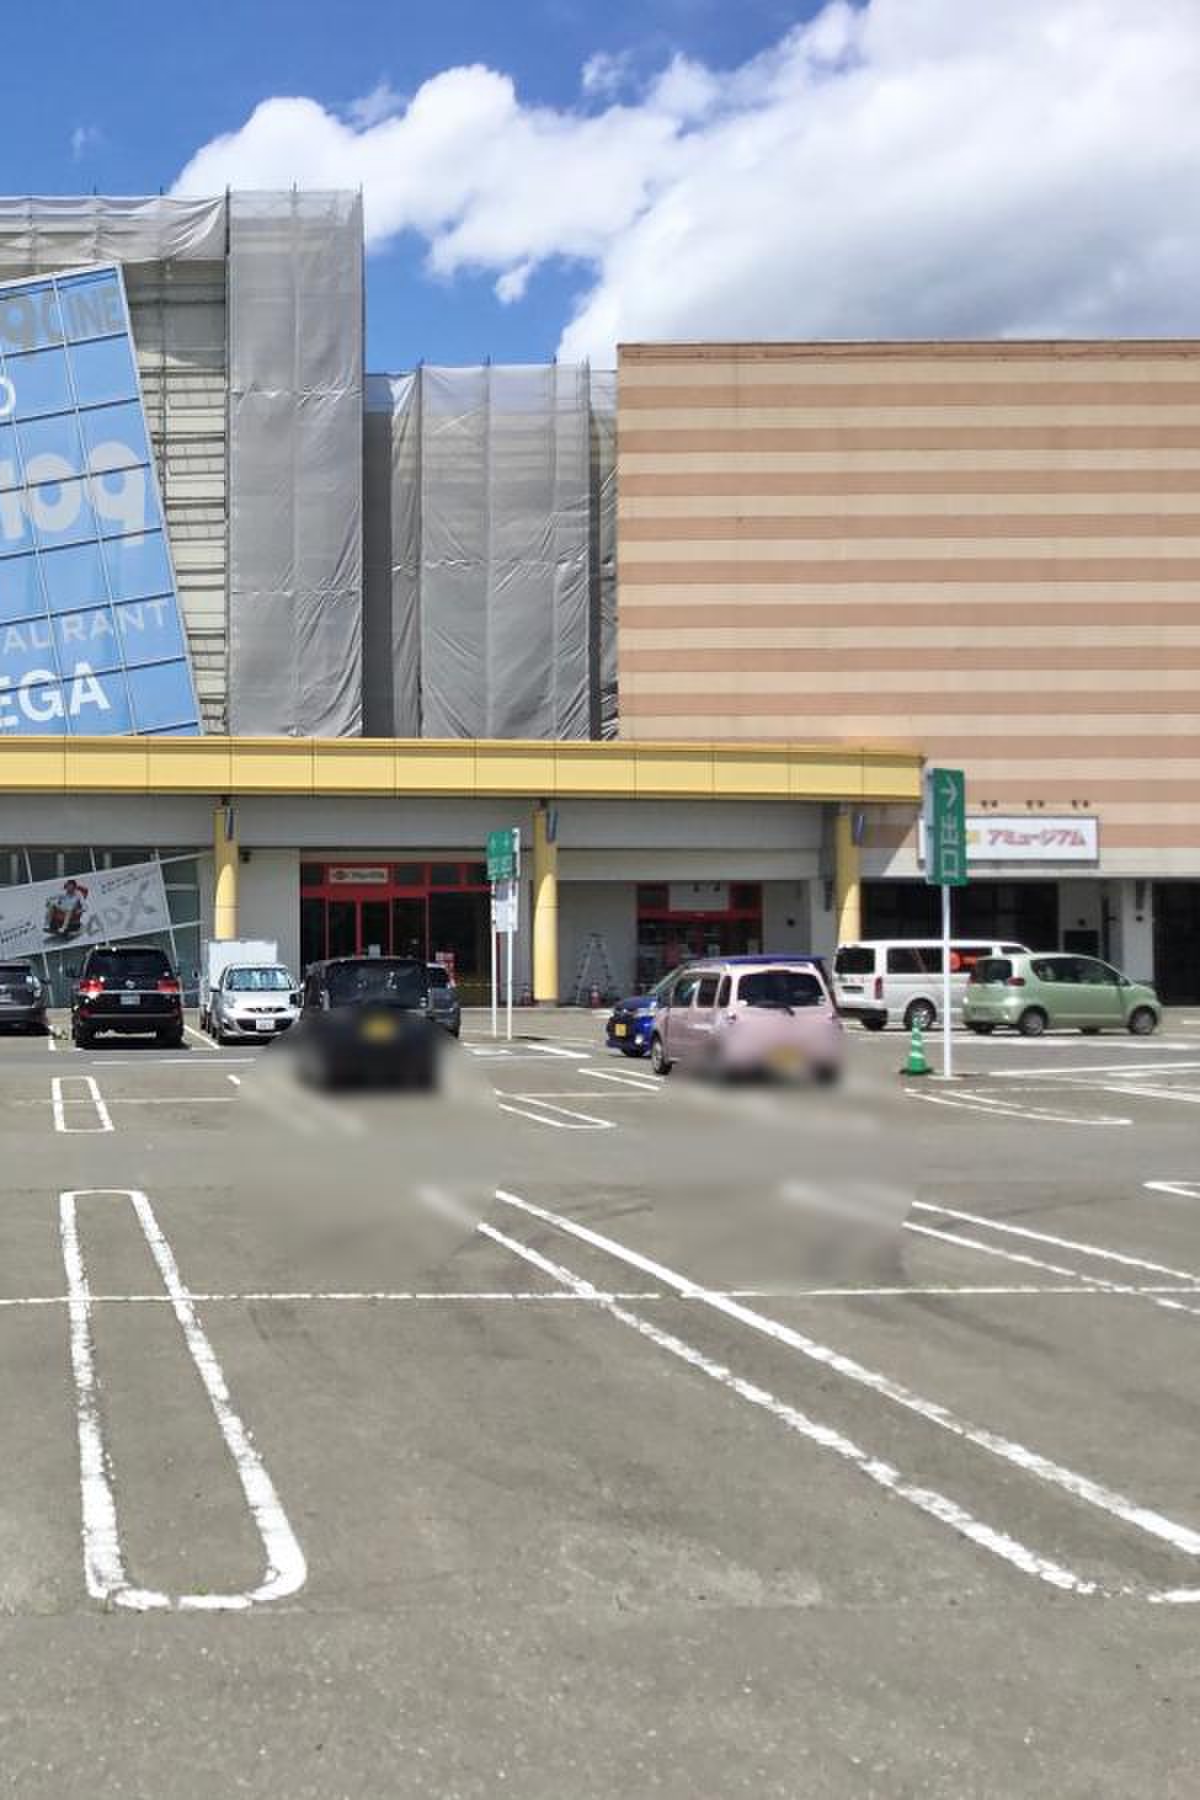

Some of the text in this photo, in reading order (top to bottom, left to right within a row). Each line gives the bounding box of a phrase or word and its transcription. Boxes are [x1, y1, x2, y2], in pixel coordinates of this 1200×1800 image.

[940, 816, 959, 879] 出口
[987, 829, 1087, 847] アミュージアム
